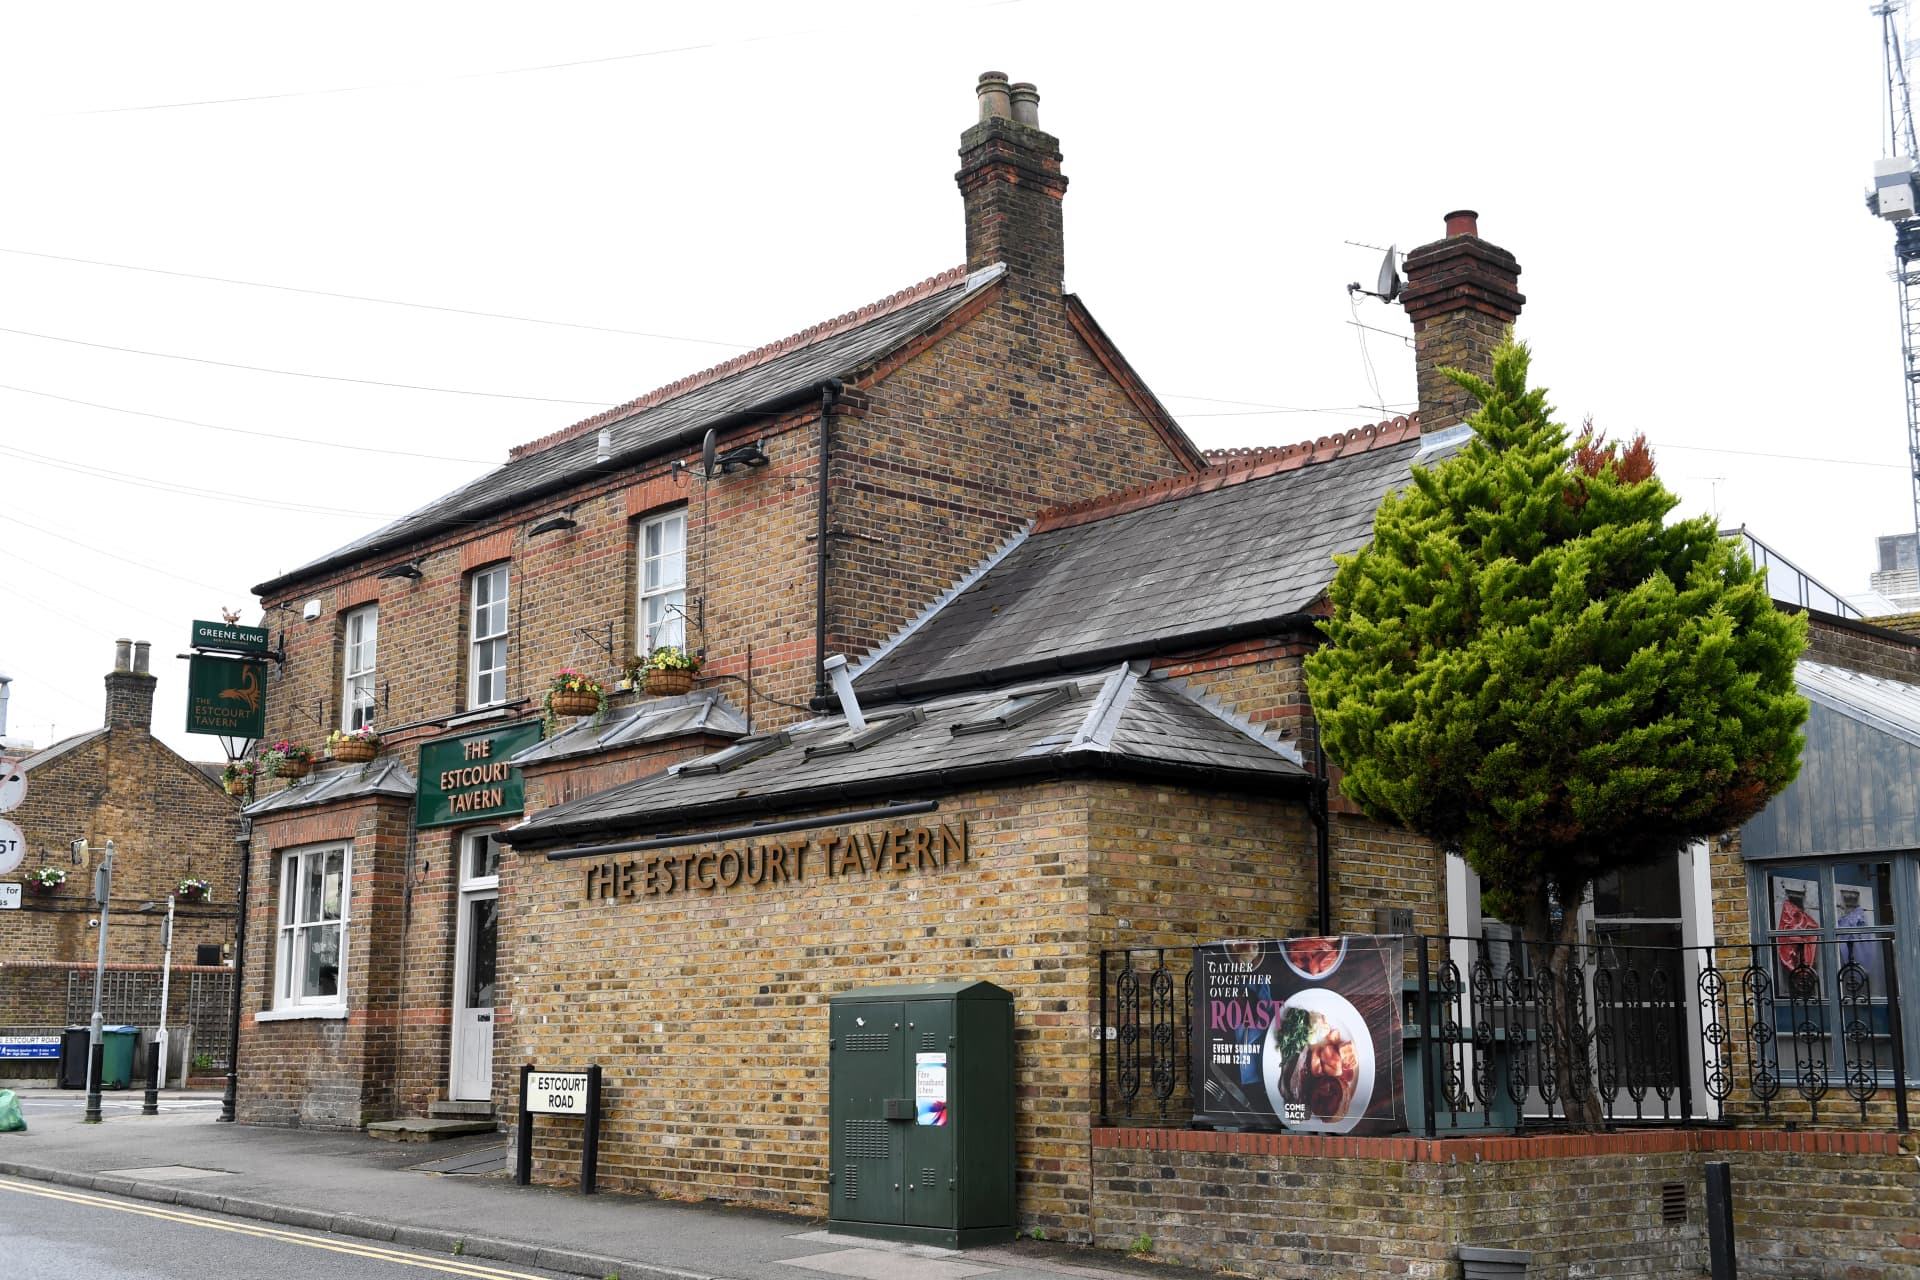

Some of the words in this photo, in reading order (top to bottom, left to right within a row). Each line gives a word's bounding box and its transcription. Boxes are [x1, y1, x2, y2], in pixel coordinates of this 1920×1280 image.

[199, 628, 237, 640] GREENE
[239, 633, 264, 643] KING
[195, 697, 210, 705] THE
[195, 705, 251, 718] ESTCOURT
[195, 716, 237, 728] TAVERN
[463, 738, 491, 761] THE
[440, 760, 511, 791] ESTCOURT
[448, 787, 503, 814] TAVERN
[581, 860, 634, 900] THE
[645, 839, 809, 897] ESTCOURT
[817, 816, 970, 878] TAVERN
[6, 887, 19, 895] for
[1207, 961, 1254, 974] GATHER
[1209, 974, 1272, 985] TOGETHER
[1209, 987, 1239, 998] OVER
[1242, 987, 1249, 998] A
[1210, 1000, 1285, 1032] ROAST
[1212, 1044, 1234, 1054] EVERY
[1234, 1044, 1261, 1054] SUNDAY
[1212, 1055, 1231, 1065] FROM
[538, 1076, 587, 1092] ESTCOURT
[548, 1094, 574, 1109] ROAD
[1285, 1111, 1305, 1119] BACK
